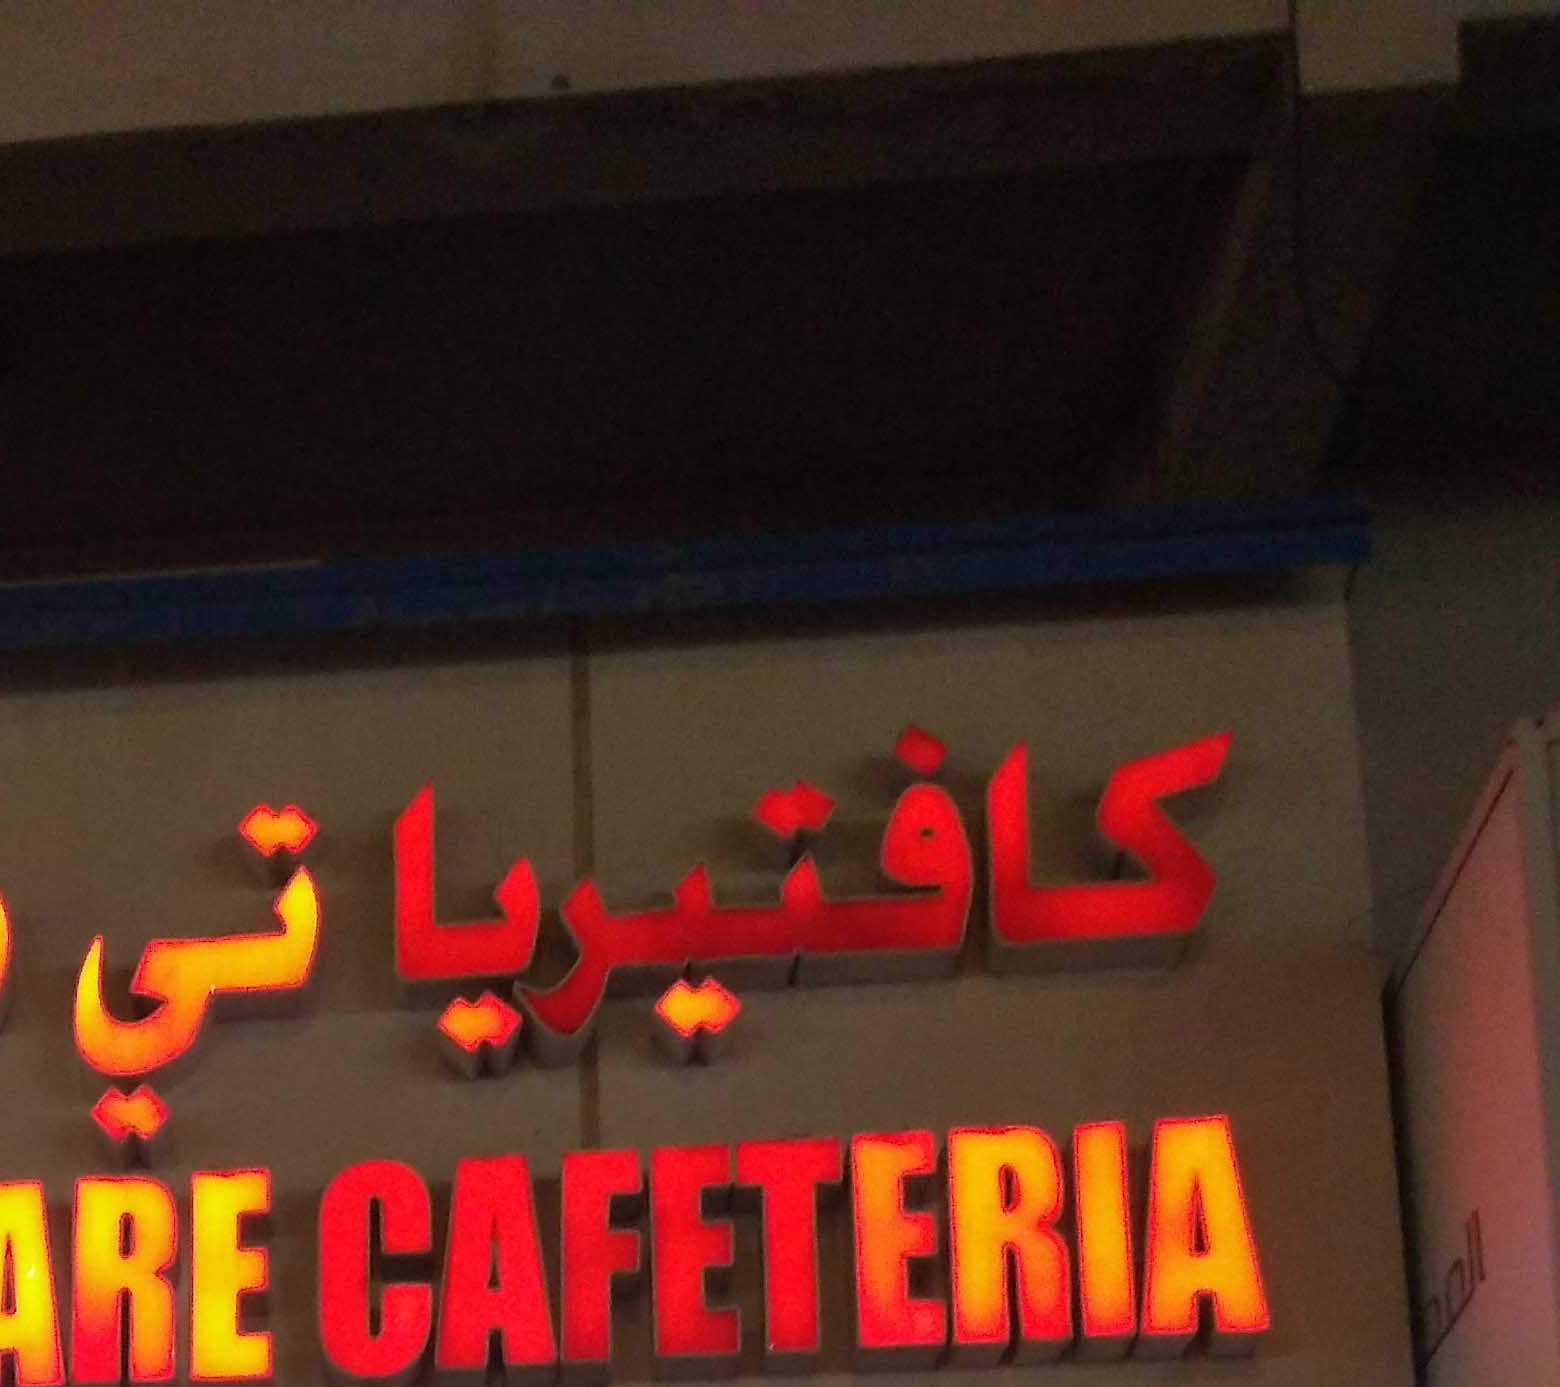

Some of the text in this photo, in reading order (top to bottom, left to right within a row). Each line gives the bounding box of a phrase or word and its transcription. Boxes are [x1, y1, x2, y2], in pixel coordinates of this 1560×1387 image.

[73, 803, 320, 1140] تي
[394, 725, 1232, 1054] كافتيريا
[318, 1113, 1270, 1378] CAFETERIA
